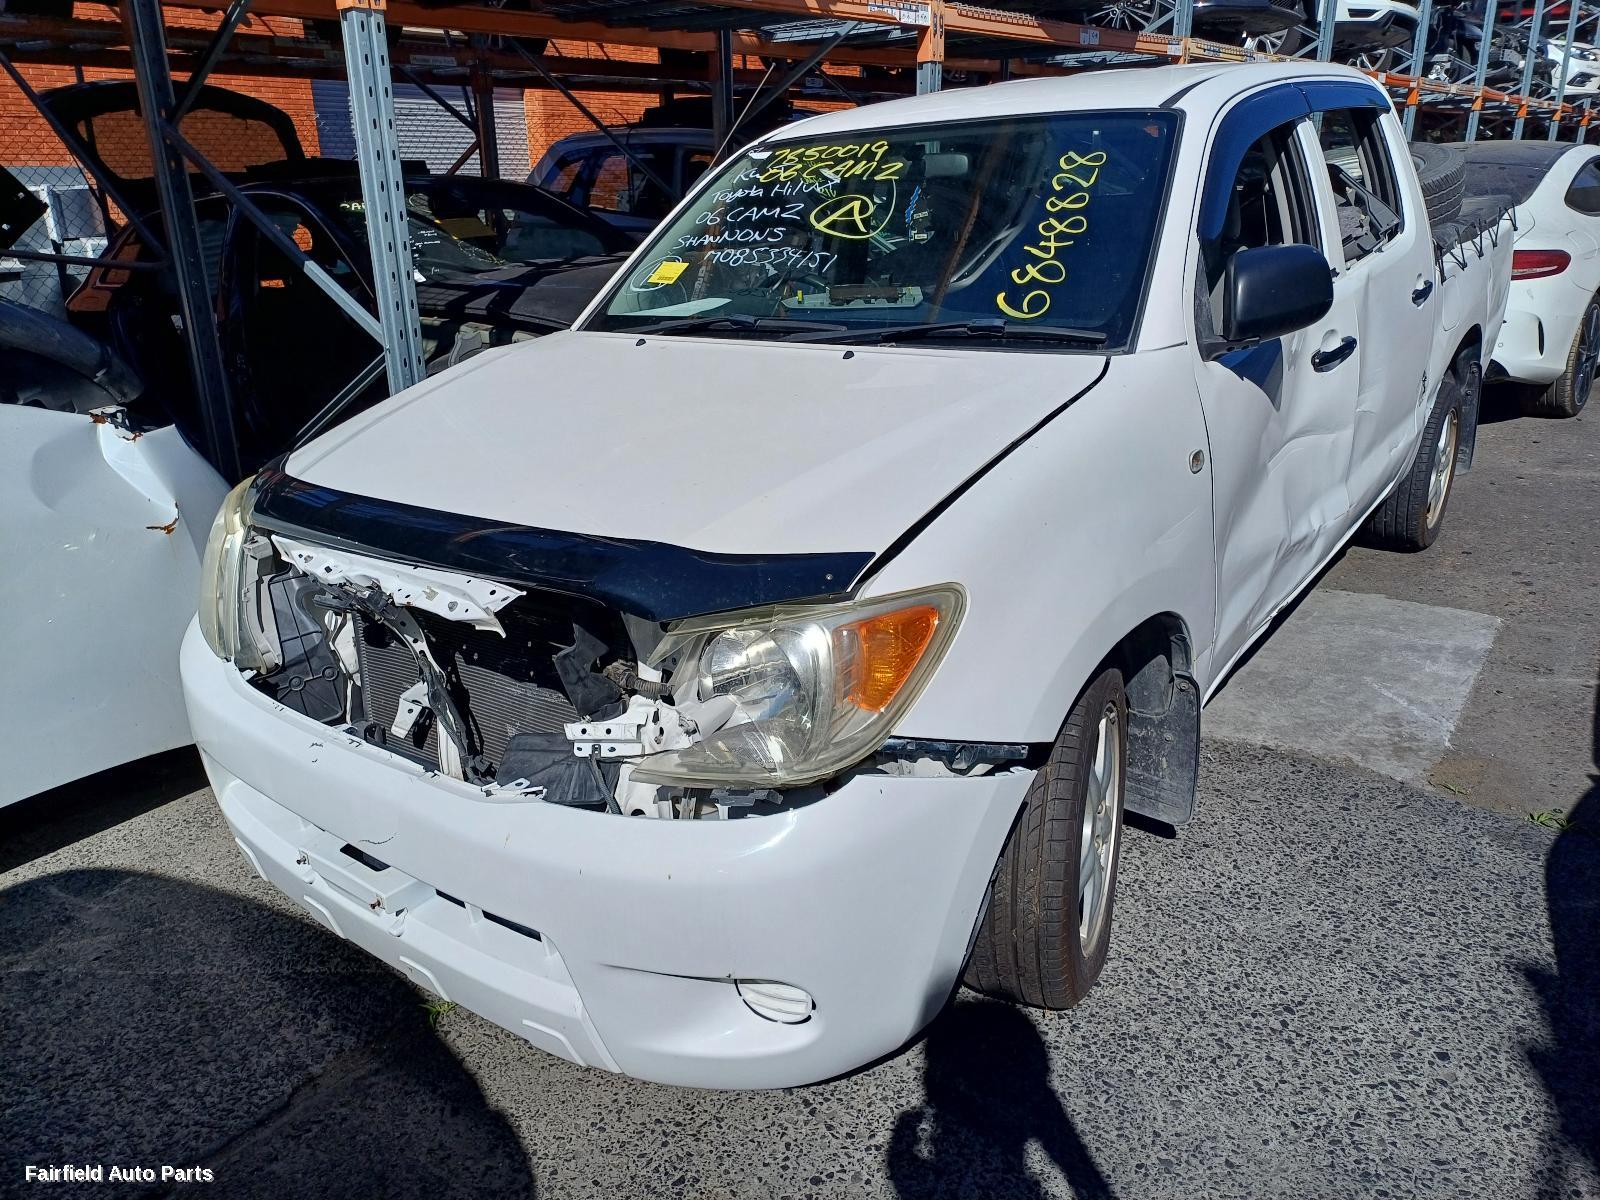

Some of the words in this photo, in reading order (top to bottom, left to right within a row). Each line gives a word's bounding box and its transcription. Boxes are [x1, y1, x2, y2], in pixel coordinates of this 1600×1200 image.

[760, 164, 802, 182] 06
[696, 207, 725, 226] 06
[812, 196, 873, 237] A
[673, 227, 787, 249] SHANNONS
[996, 151, 1107, 319] 6848828
